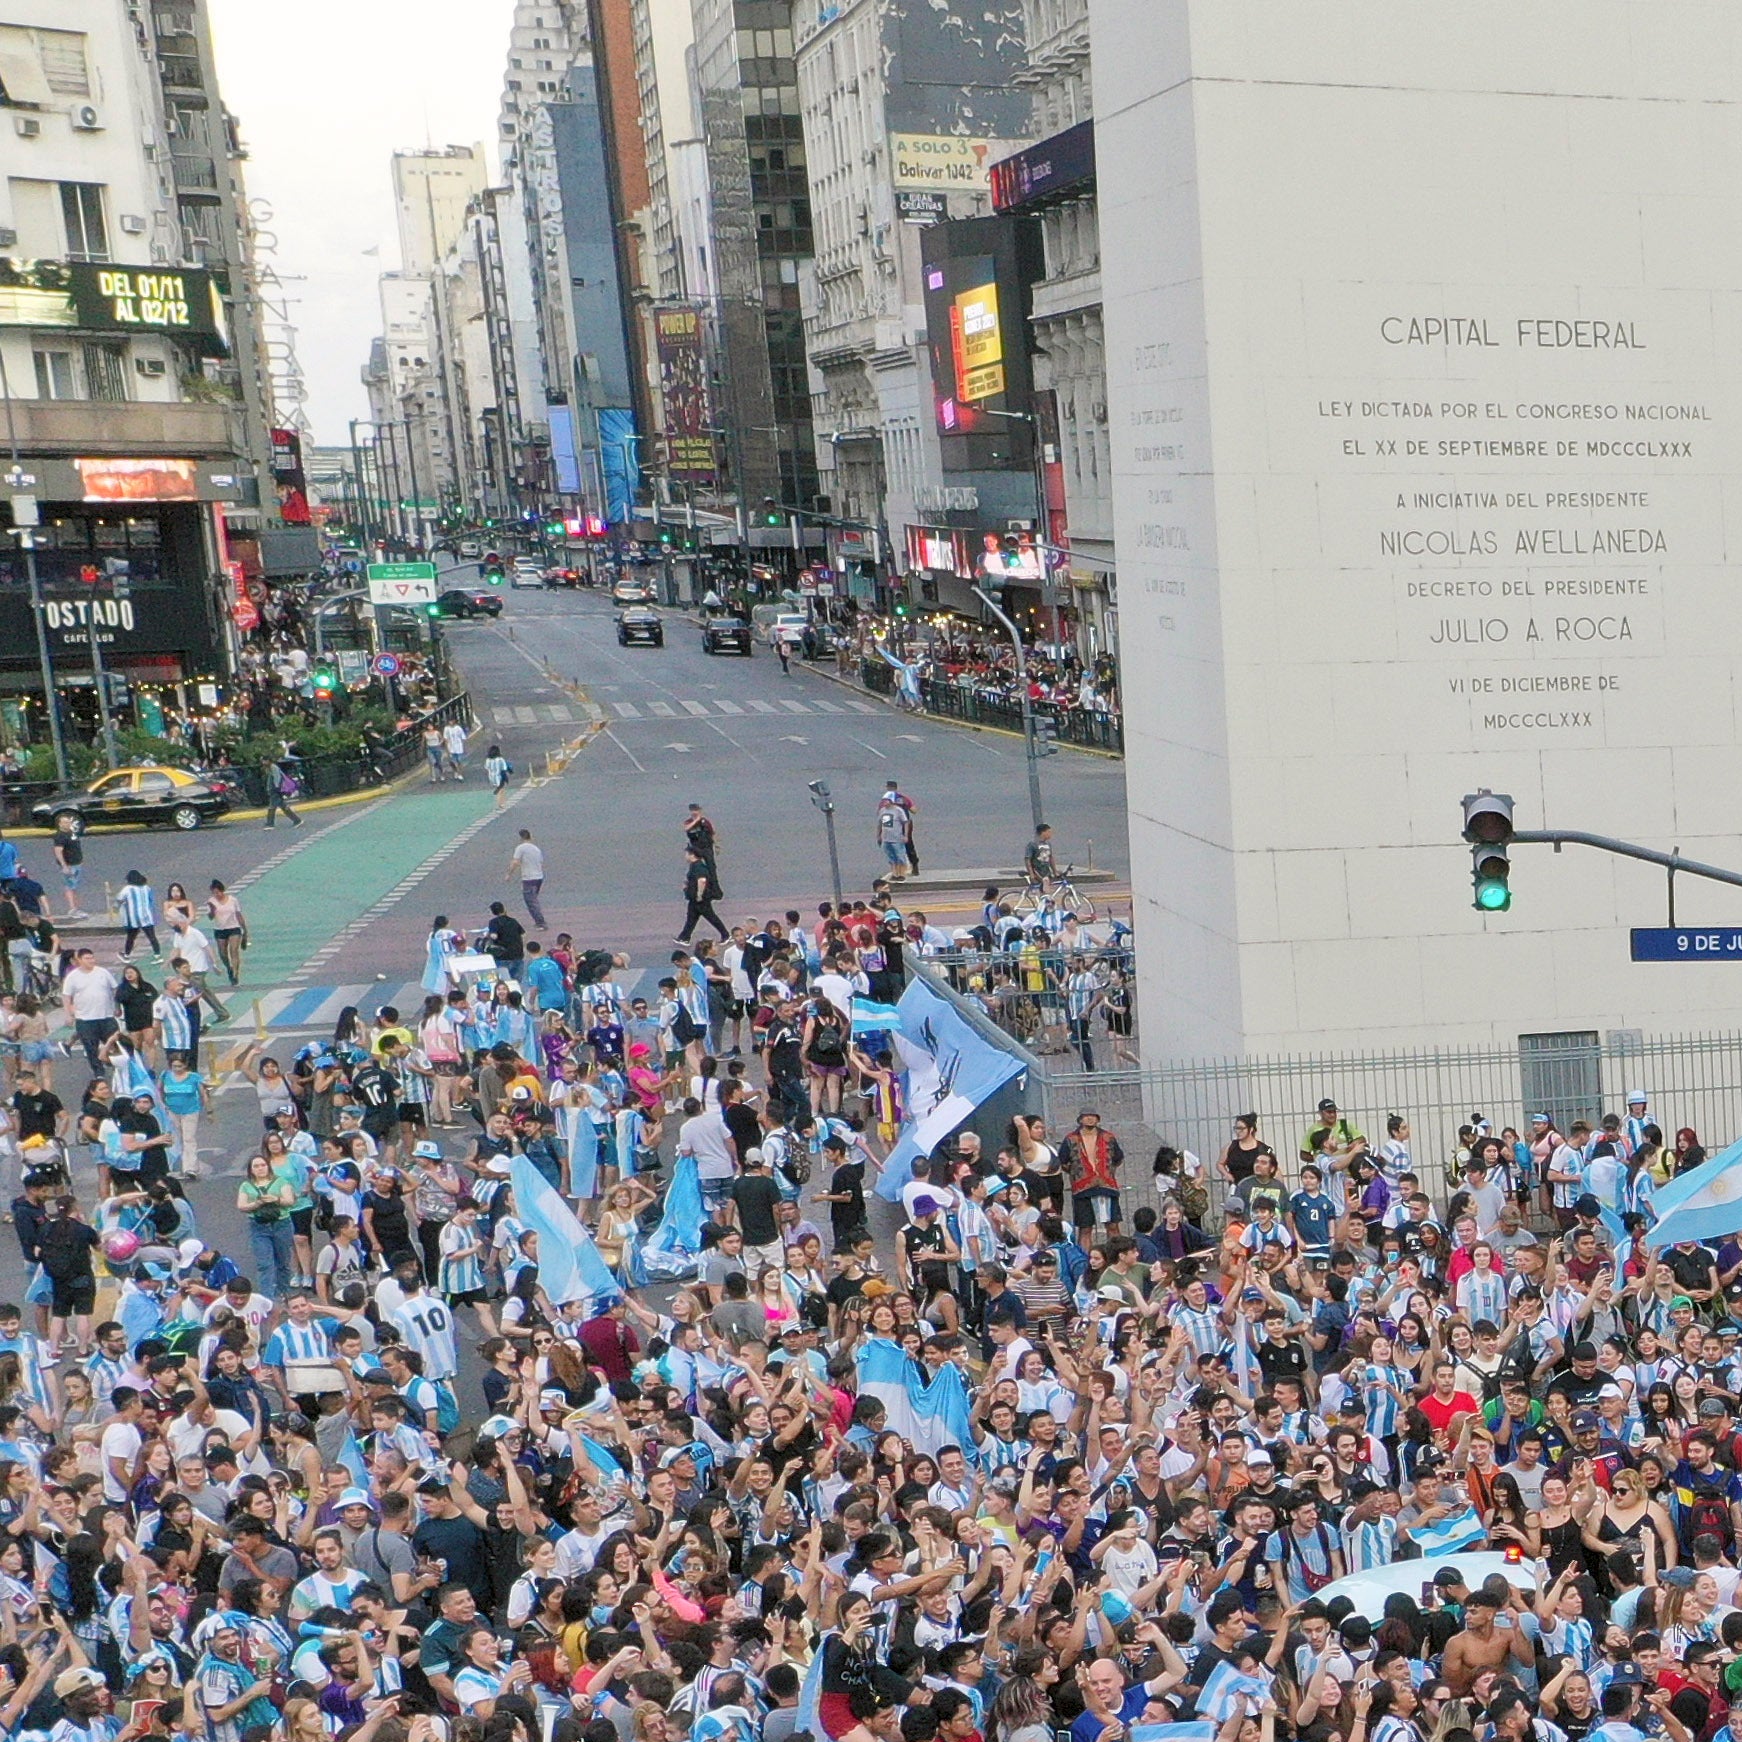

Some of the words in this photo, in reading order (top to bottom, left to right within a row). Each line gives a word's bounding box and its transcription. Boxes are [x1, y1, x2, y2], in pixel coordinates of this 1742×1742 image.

[912, 140, 951, 154] SOLO
[98, 271, 136, 297] DEL
[137, 274, 185, 300] 01/11
[115, 298, 140, 322] AL
[142, 302, 190, 326] 02/12
[1380, 316, 1500, 347] CAPITAL
[1517, 318, 1648, 349] FEDERAL
[1317, 400, 1354, 418] LEY
[1361, 401, 1433, 418] DICTADA
[1440, 402, 1477, 419] POR
[1485, 402, 1508, 419] EL
[1515, 402, 1618, 421] CONGRESO
[1625, 404, 1712, 421] NACIONAL
[1342, 439, 1366, 456] EL
[1374, 439, 1397, 456] XX
[1406, 439, 1430, 456] DE
[1437, 439, 1549, 457] SEPTIEMBRE
[1556, 440, 1579, 457] DE
[1586, 440, 1693, 458] MDCCCLXXX
[1396, 493, 1406, 508] A
[1413, 492, 1498, 509] INICIATIVA
[1505, 492, 1539, 508] DEL
[1546, 491, 1650, 508] PRESIDENTE
[1380, 529, 1498, 556] NICOLAS
[1514, 528, 1668, 555] AVELLANEDA
[1407, 581, 1492, 598] DECRETO
[1501, 580, 1536, 597] DEL
[1544, 579, 1649, 596] PRESIDENTE
[1429, 617, 1509, 644] JULIO
[1525, 616, 1544, 642] A.
[1556, 615, 1633, 642] ROCA
[1448, 677, 1465, 694] VI
[1471, 677, 1493, 694] DE
[1500, 675, 1593, 693] DICIEMBRE
[1597, 675, 1620, 692] DE
[1483, 712, 1593, 730] MDCCCLXXX
[1677, 935, 1689, 951] 9
[1695, 935, 1722, 951] DE
